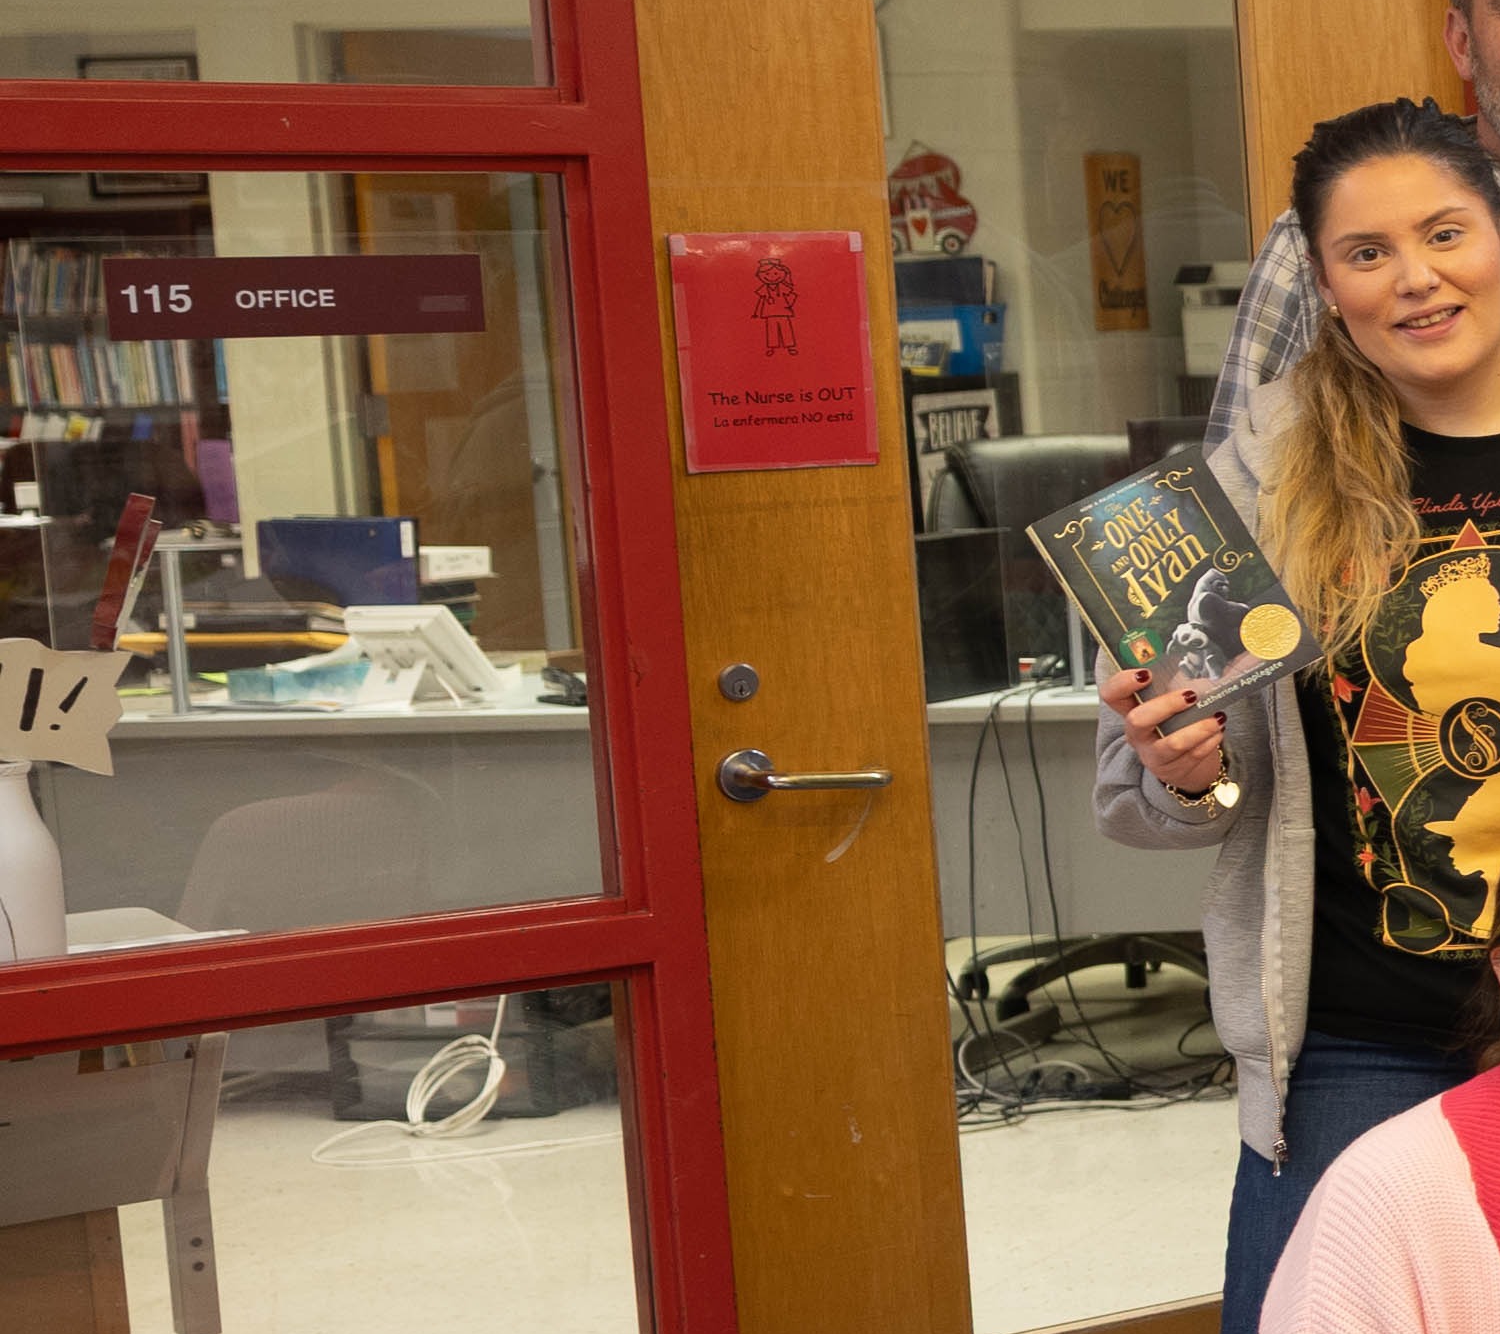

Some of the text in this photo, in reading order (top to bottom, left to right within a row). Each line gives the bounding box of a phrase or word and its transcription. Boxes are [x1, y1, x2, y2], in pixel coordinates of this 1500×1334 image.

[1103, 169, 1130, 194] WE
[120, 284, 336, 316] 115 OFFICE
[708, 387, 856, 406] The Nurse is OUT
[714, 411, 853, 428] La enfermera NO está
[1104, 498, 1154, 549] ONE
[1129, 508, 1188, 569] ONLY
[1120, 534, 1210, 619] Ivan
